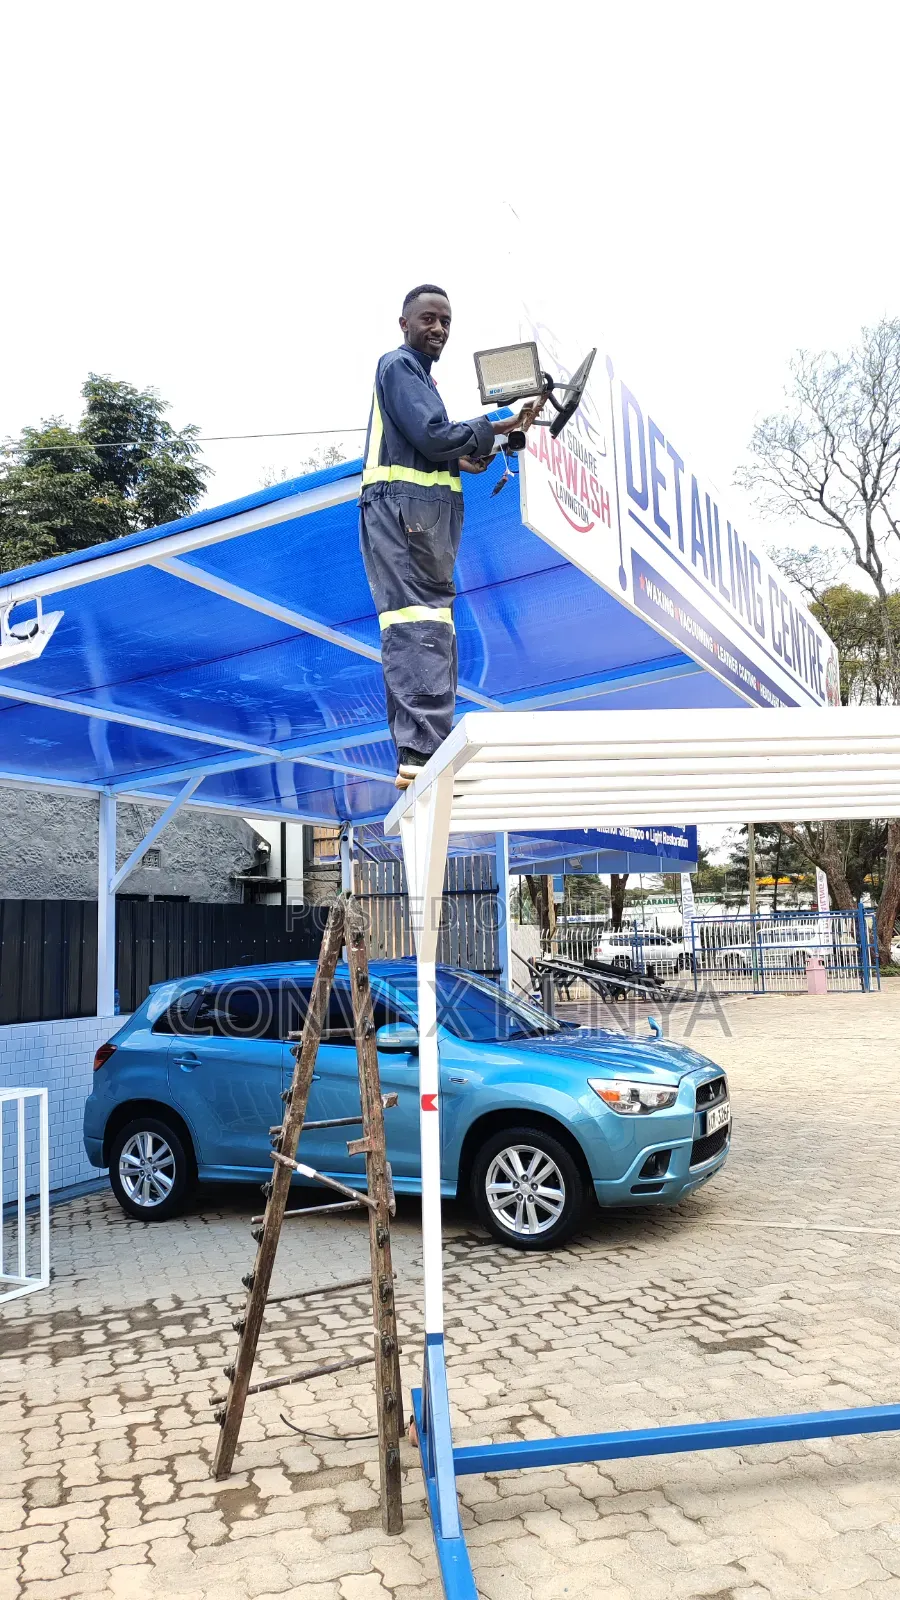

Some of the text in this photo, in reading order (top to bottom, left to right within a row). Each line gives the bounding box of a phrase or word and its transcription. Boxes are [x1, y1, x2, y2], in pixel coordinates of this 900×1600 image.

[525, 425, 611, 528] CARWASH
[567, 430, 598, 478] SQUARE
[555, 481, 590, 525] LAVINGTON
[620, 380, 825, 702] DETAILING CENTRE
[645, 576, 675, 619] WAXING
[650, 829, 662, 847] Light
[663, 832, 689, 848] Restoration
